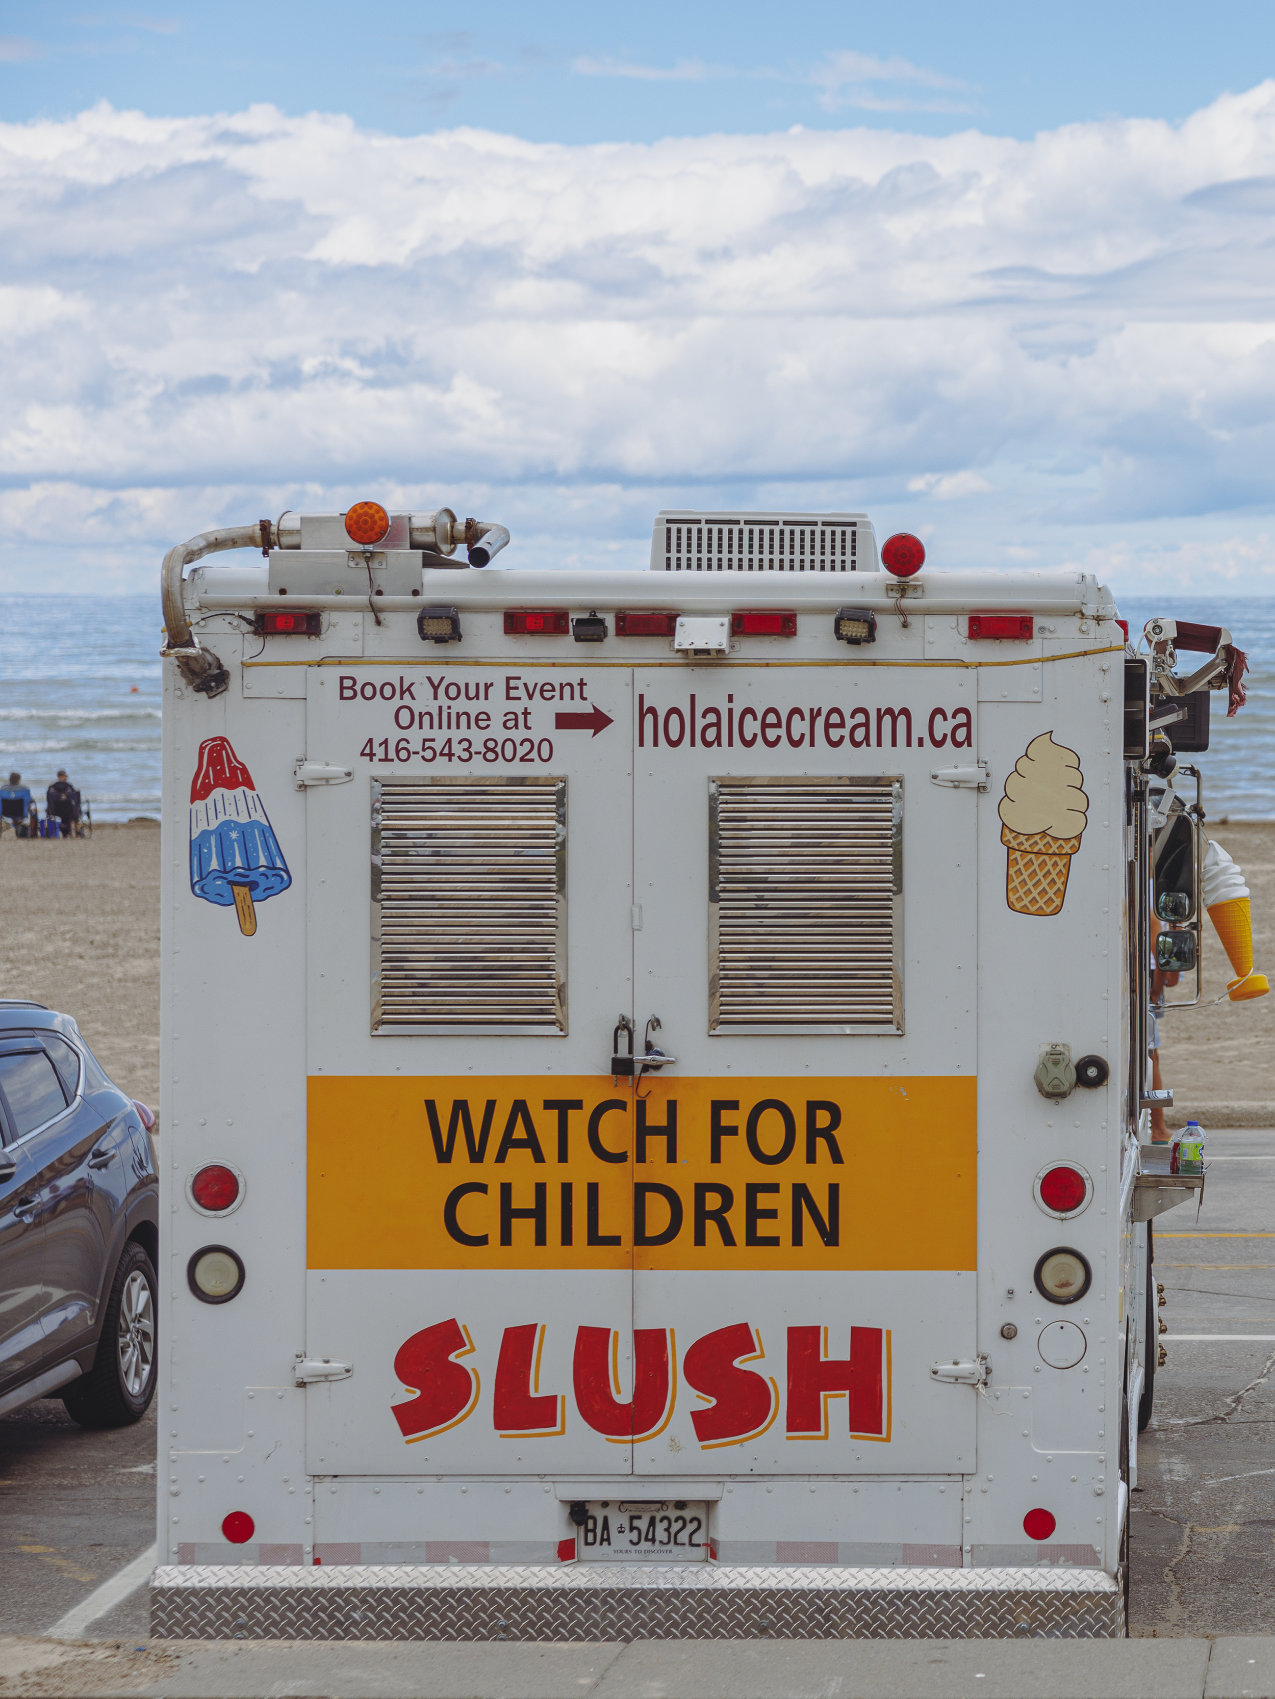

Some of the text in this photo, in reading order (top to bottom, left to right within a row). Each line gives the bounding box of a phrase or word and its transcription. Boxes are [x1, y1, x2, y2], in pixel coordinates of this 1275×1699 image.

[338, 676, 588, 702] Book Your Event
[393, 704, 532, 731] Online at
[638, 694, 974, 749] holaicecream.ca
[359, 737, 554, 763] 416-543-8020
[424, 1099, 844, 1165] WATCH FOR
[443, 1181, 840, 1248] CHILDREN
[390, 1317, 891, 1450] SLUSH
[584, 1514, 702, 1548] BA 54322
